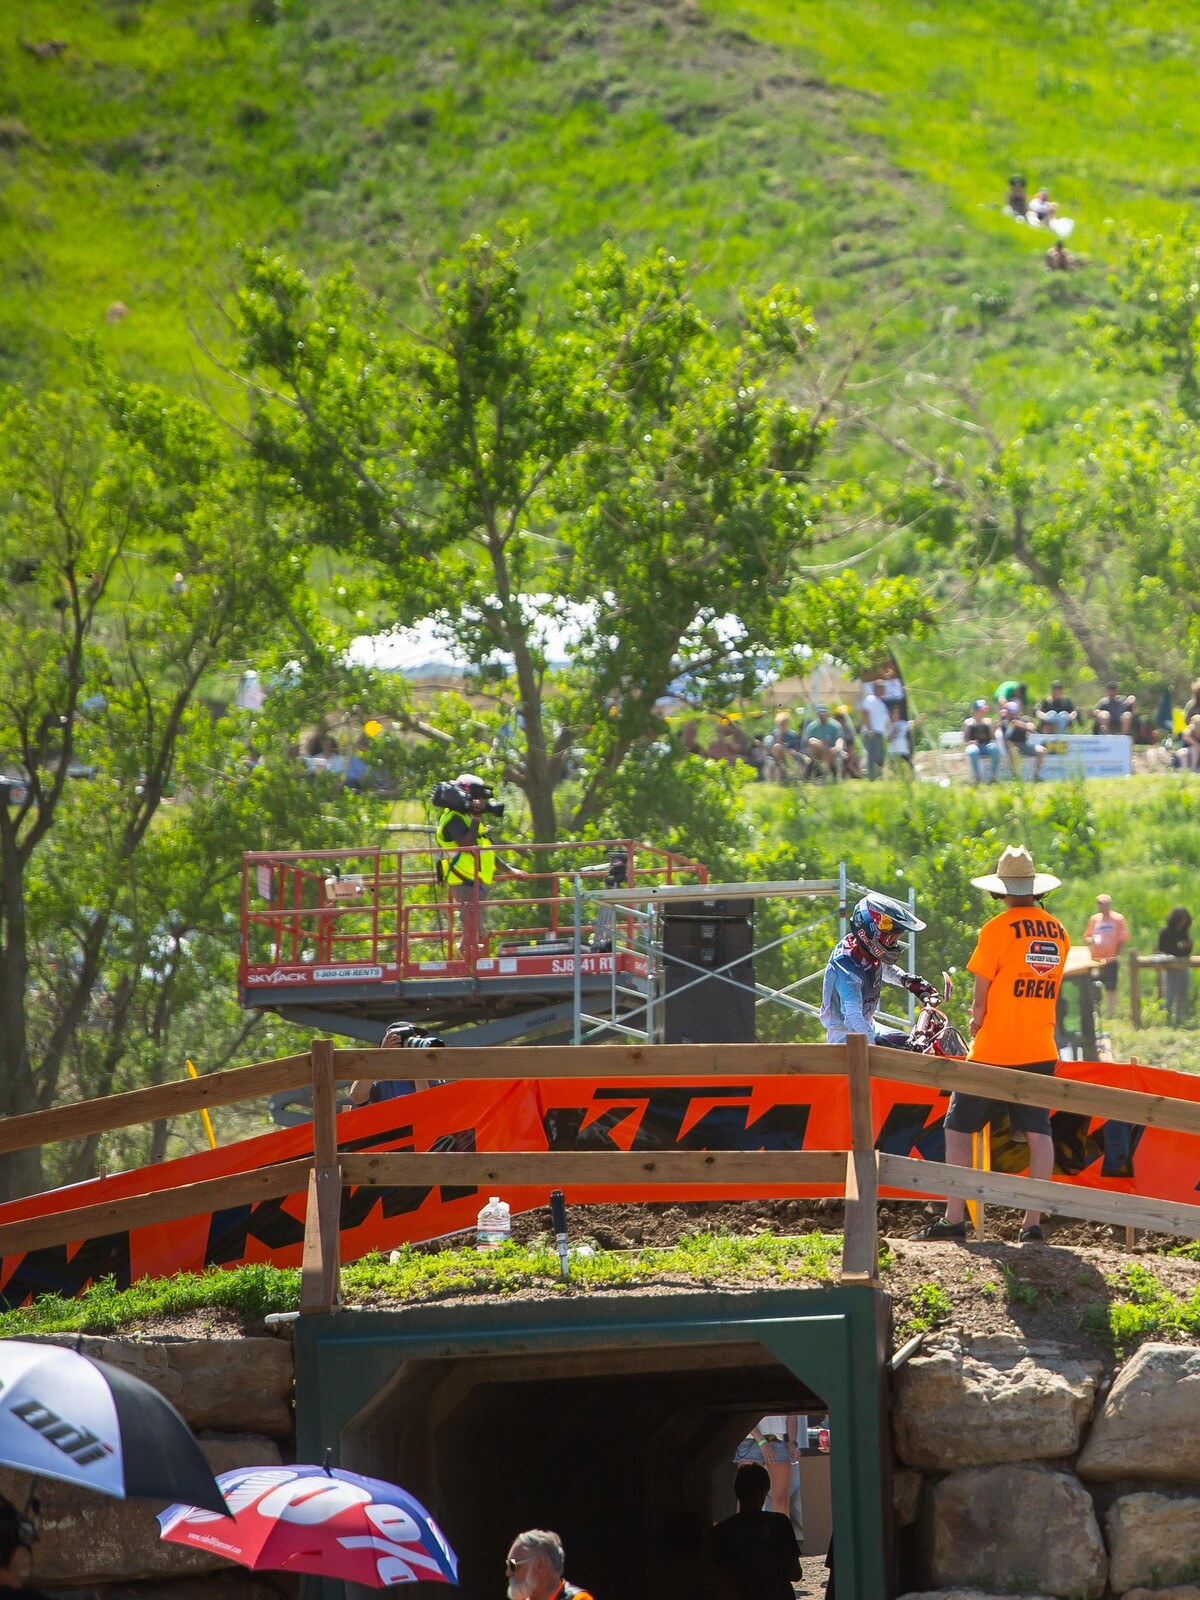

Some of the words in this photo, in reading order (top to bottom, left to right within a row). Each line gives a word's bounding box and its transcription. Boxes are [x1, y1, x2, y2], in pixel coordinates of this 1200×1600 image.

[552, 957, 595, 972] SJ841
[247, 969, 307, 985] SKYJACK
[315, 968, 380, 978] 1-800-UR-RENTS
[546, 1085, 812, 1152] KTM
